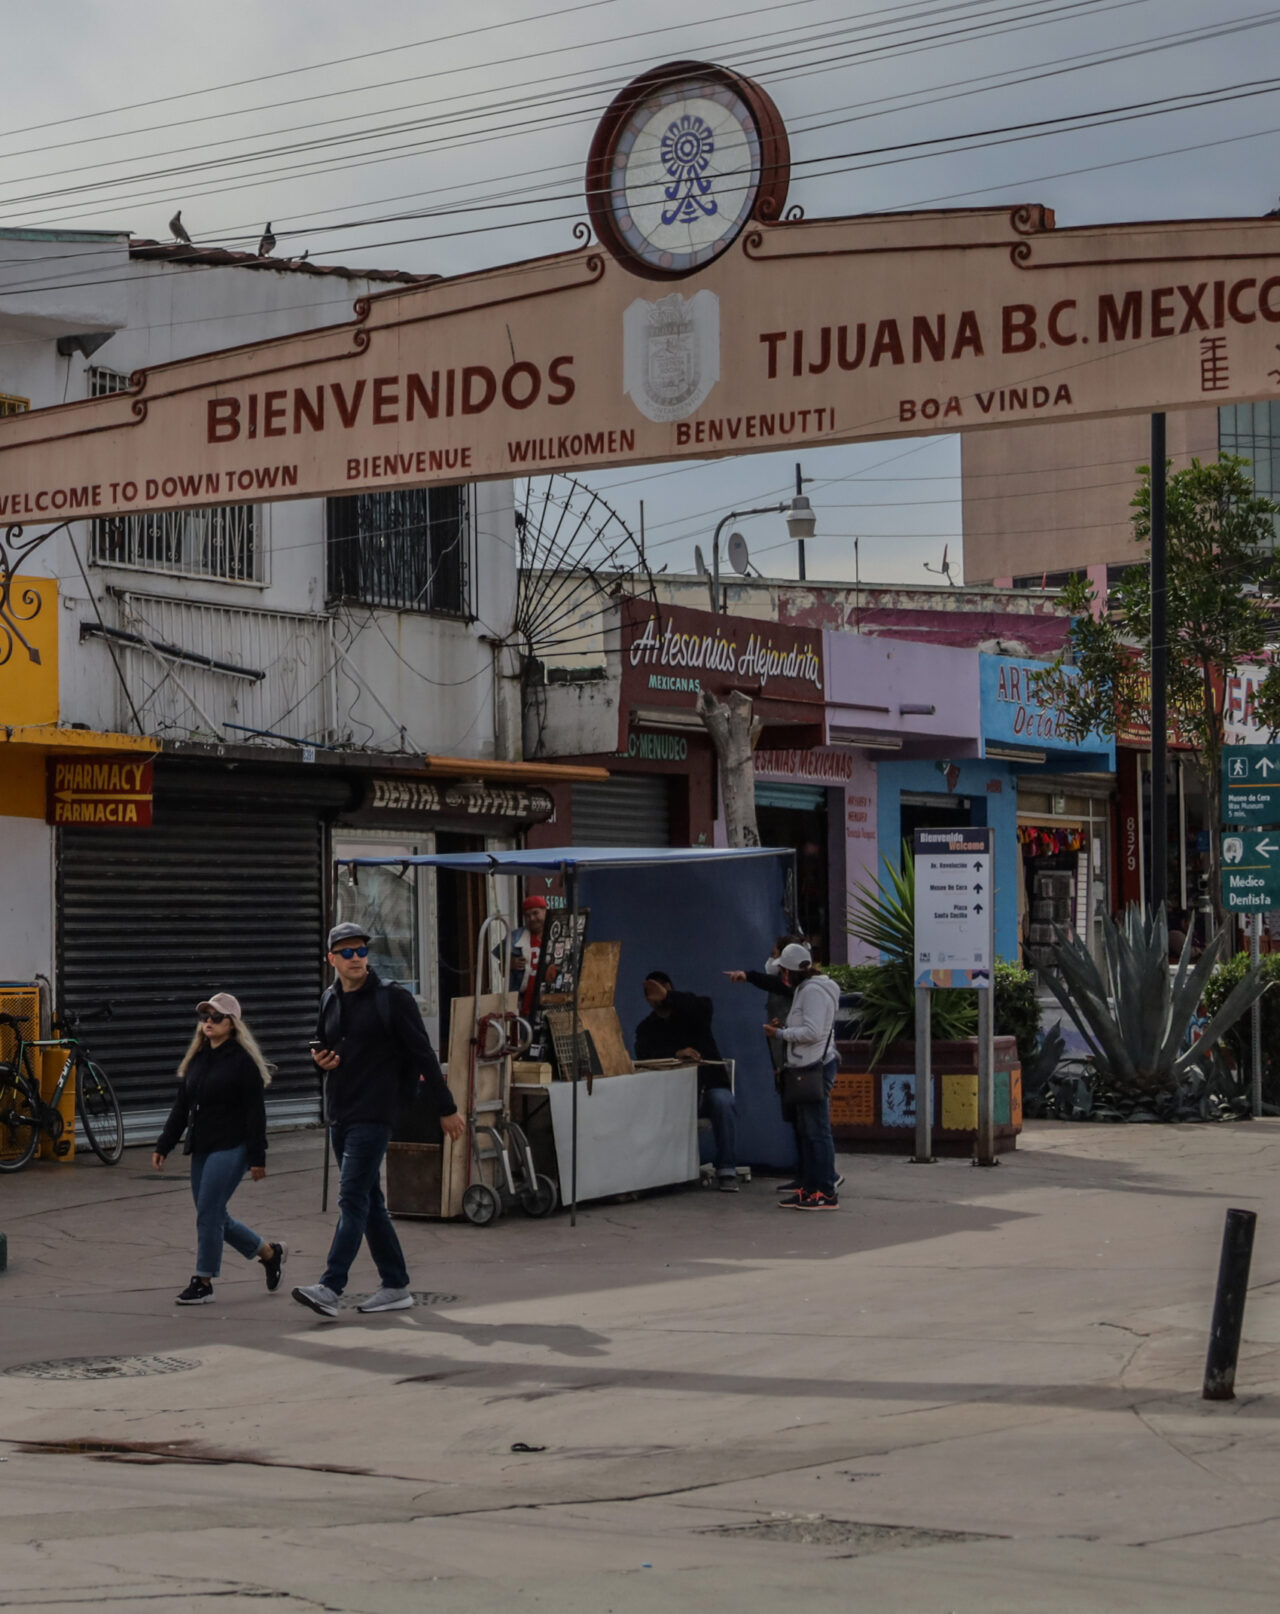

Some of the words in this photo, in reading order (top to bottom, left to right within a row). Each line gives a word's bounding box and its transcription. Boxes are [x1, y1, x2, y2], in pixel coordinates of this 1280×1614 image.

[759, 310, 984, 379] TIJUANA
[1002, 299, 1088, 354] B.C.
[1098, 275, 1280, 344] MEXICO
[206, 355, 576, 444] BIENVENIDOS
[899, 395, 963, 422] BOA
[975, 383, 1073, 414] VINDA
[675, 407, 836, 446] BENVENUTTI
[507, 428, 635, 463] WILLKOMEN
[346, 448, 471, 481] BIENVENUE
[109, 482, 138, 503] TO
[630, 614, 736, 671] Artesanias
[738, 632, 822, 690] Alejandrita
[648, 674, 701, 693] MEXICANAS
[55, 764, 144, 791] PHARMACY
[798, 751, 853, 781] MEXICANAS
[55, 803, 138, 822] FARMACIA
[372, 780, 440, 811] DENTAL
[468, 788, 529, 817] OFFICE
[920, 832, 963, 843] Bienvenido
[949, 842, 985, 851] Welcome
[1127, 817, 1136, 871] 8379
[1229, 893, 1271, 906] Dentista
